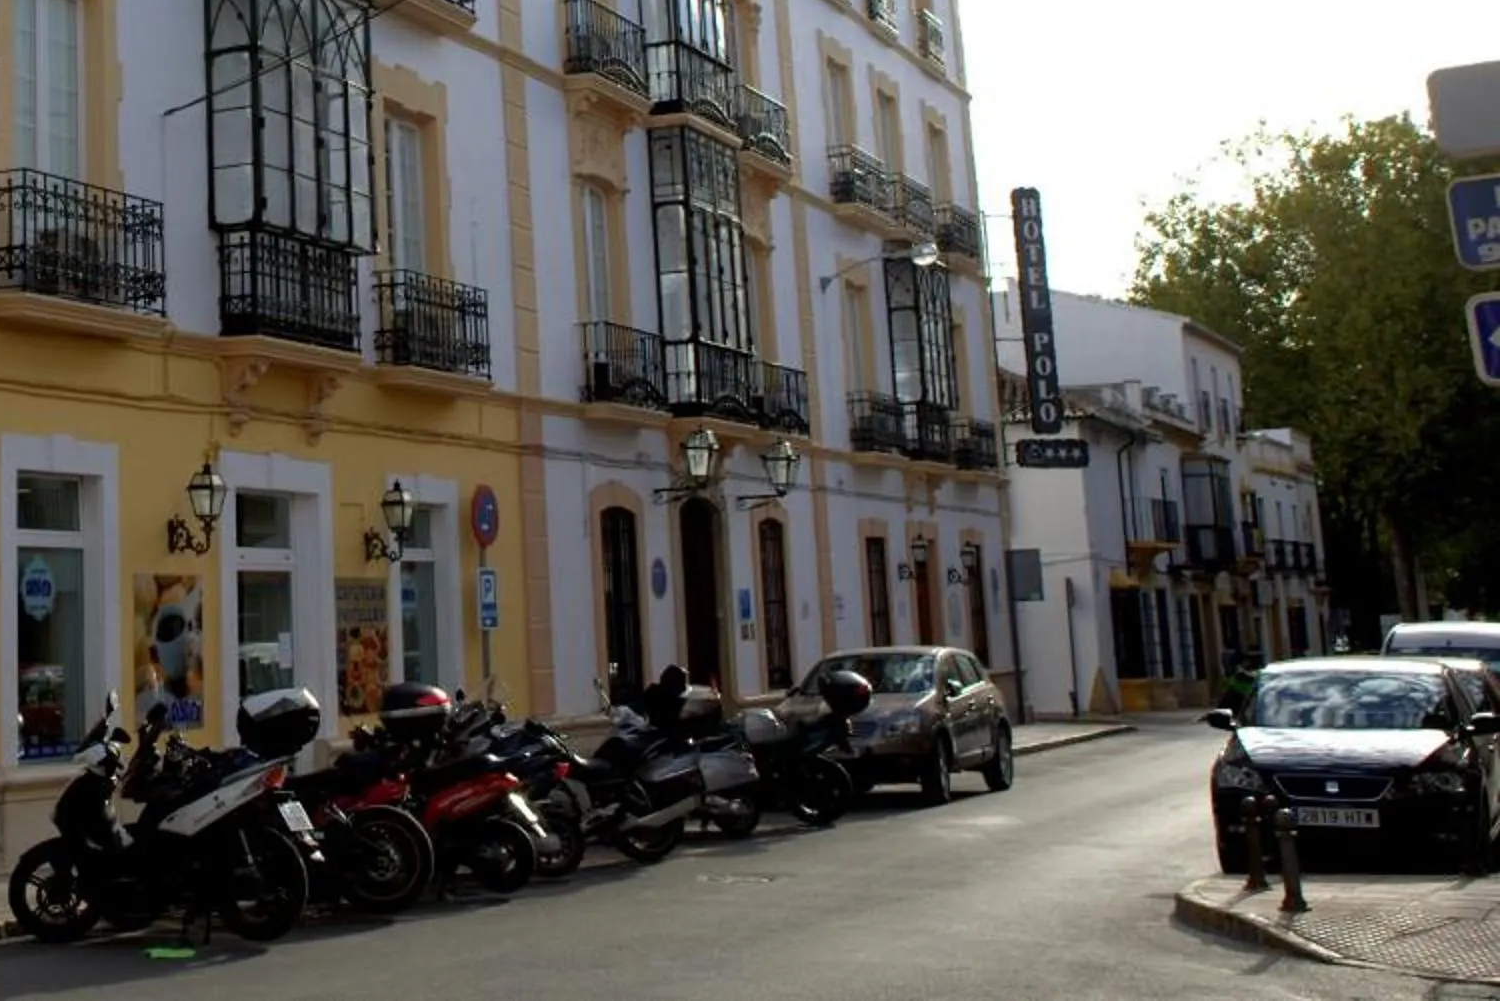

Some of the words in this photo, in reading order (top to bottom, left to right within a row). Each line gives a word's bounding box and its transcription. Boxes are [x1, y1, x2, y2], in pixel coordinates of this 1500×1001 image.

[1020, 197, 1047, 310] HOTEL
[1033, 332, 1056, 424] POLO
[483, 578, 492, 599] P
